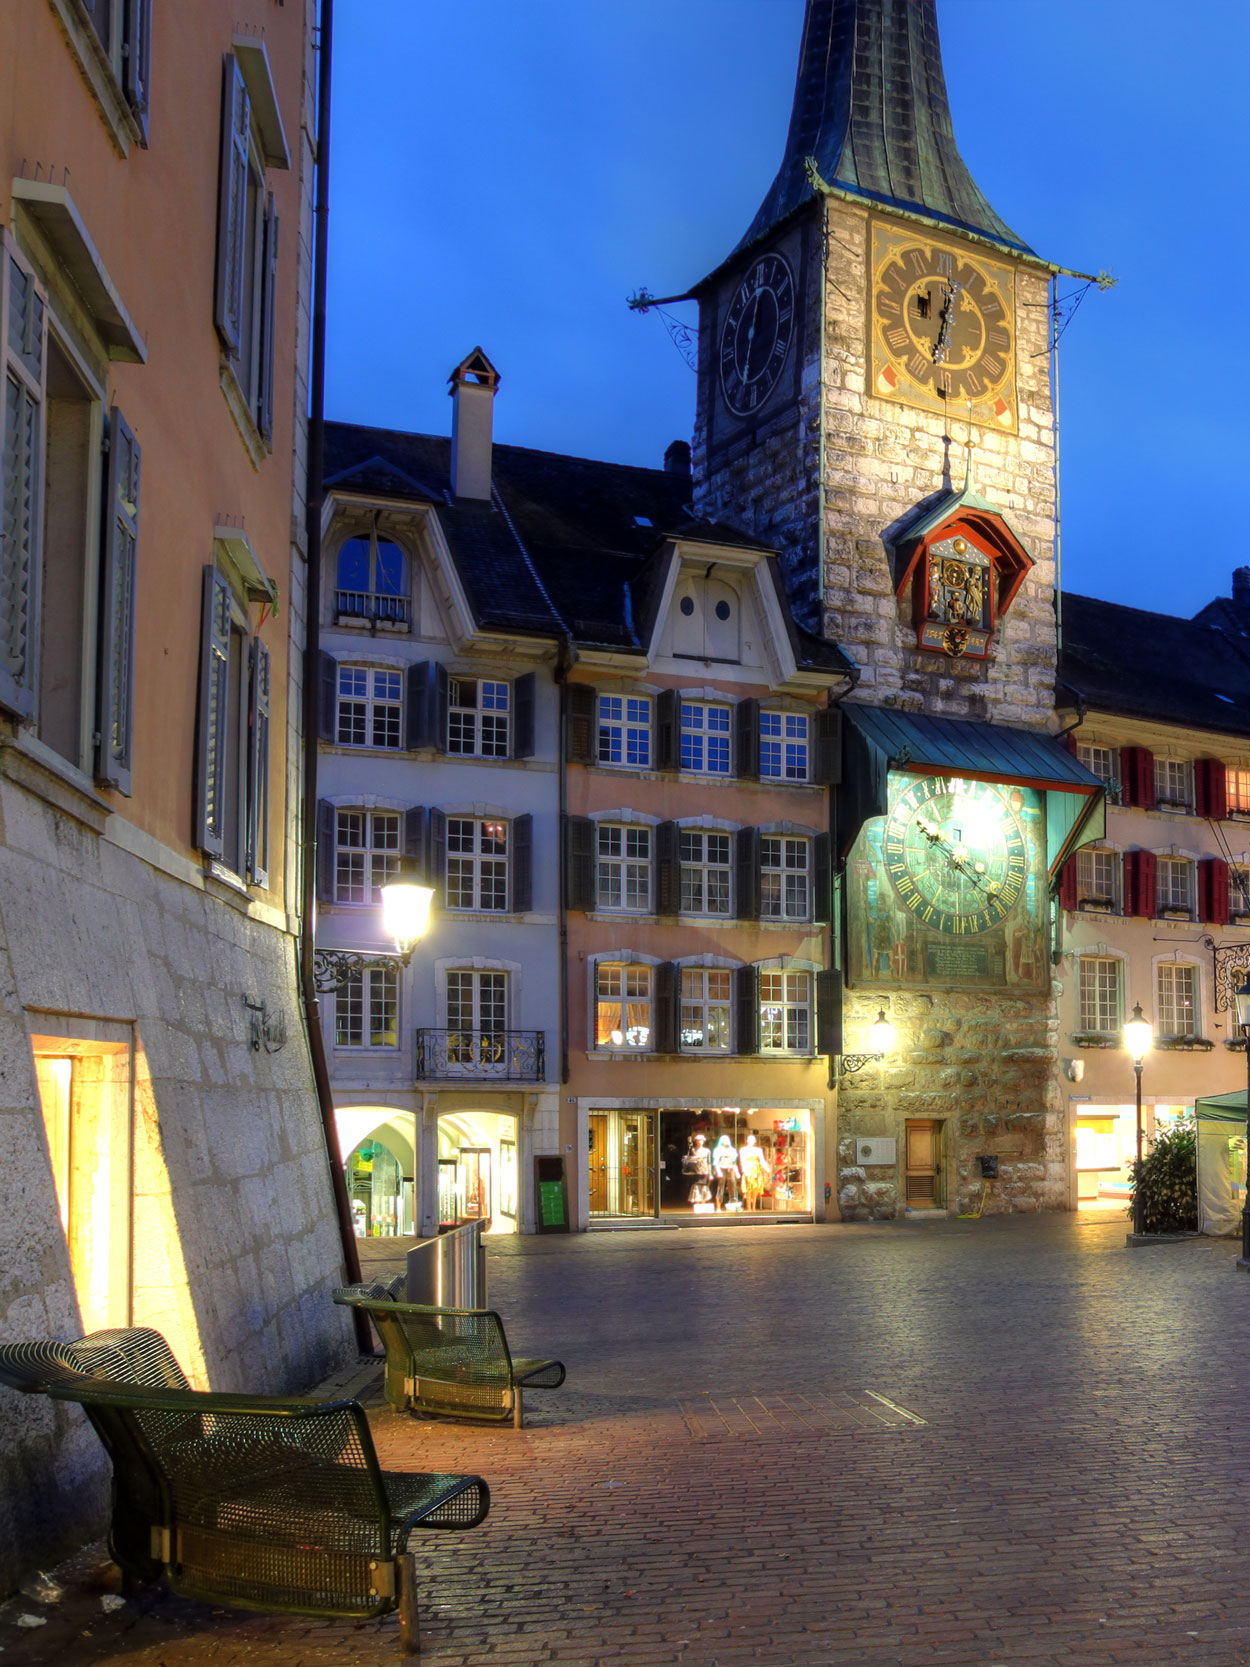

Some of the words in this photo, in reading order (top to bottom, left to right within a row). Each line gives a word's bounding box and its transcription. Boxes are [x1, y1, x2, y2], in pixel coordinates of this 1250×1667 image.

[910, 251, 927, 276] XI
[937, 252, 953, 277] XII
[889, 266, 907, 290] X
[965, 272, 978, 289] I
[921, 780, 931, 799] X
[939, 913, 945, 930] I
